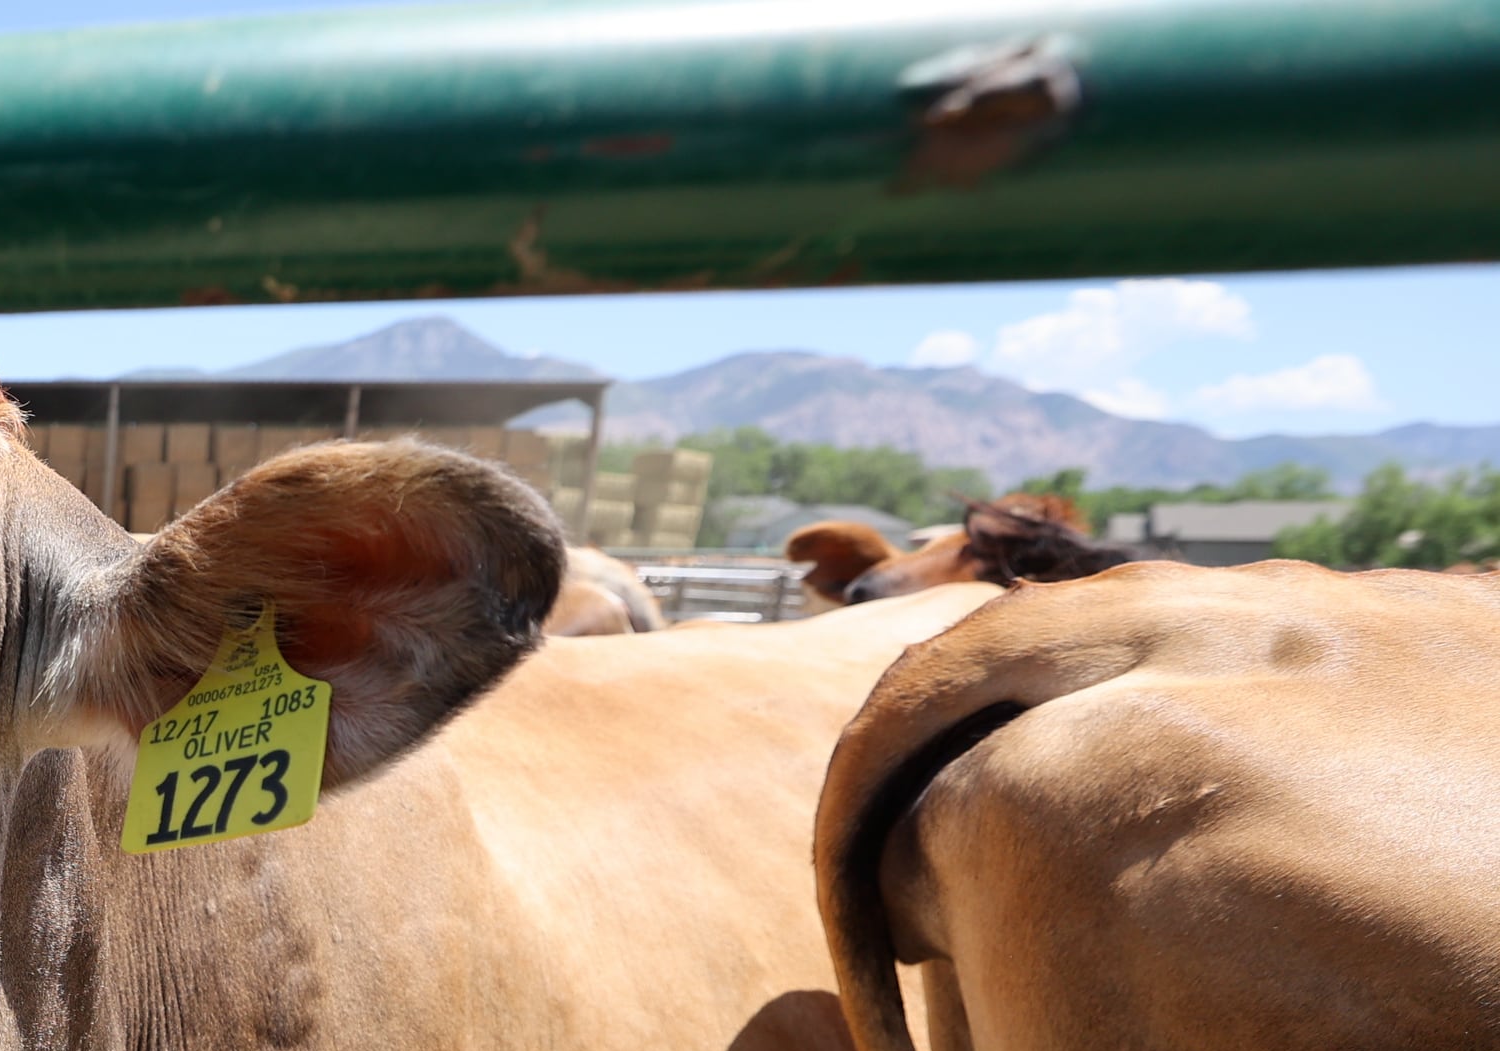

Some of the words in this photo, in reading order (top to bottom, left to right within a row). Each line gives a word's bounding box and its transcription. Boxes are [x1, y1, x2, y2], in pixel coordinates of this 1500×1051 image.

[187, 672, 283, 707] 000067821273
[254, 662, 281, 677] USA
[150, 710, 219, 744] 12/17
[260, 684, 317, 720] 1083
[184, 720, 273, 760] OLIVER
[146, 749, 291, 846] 1273
